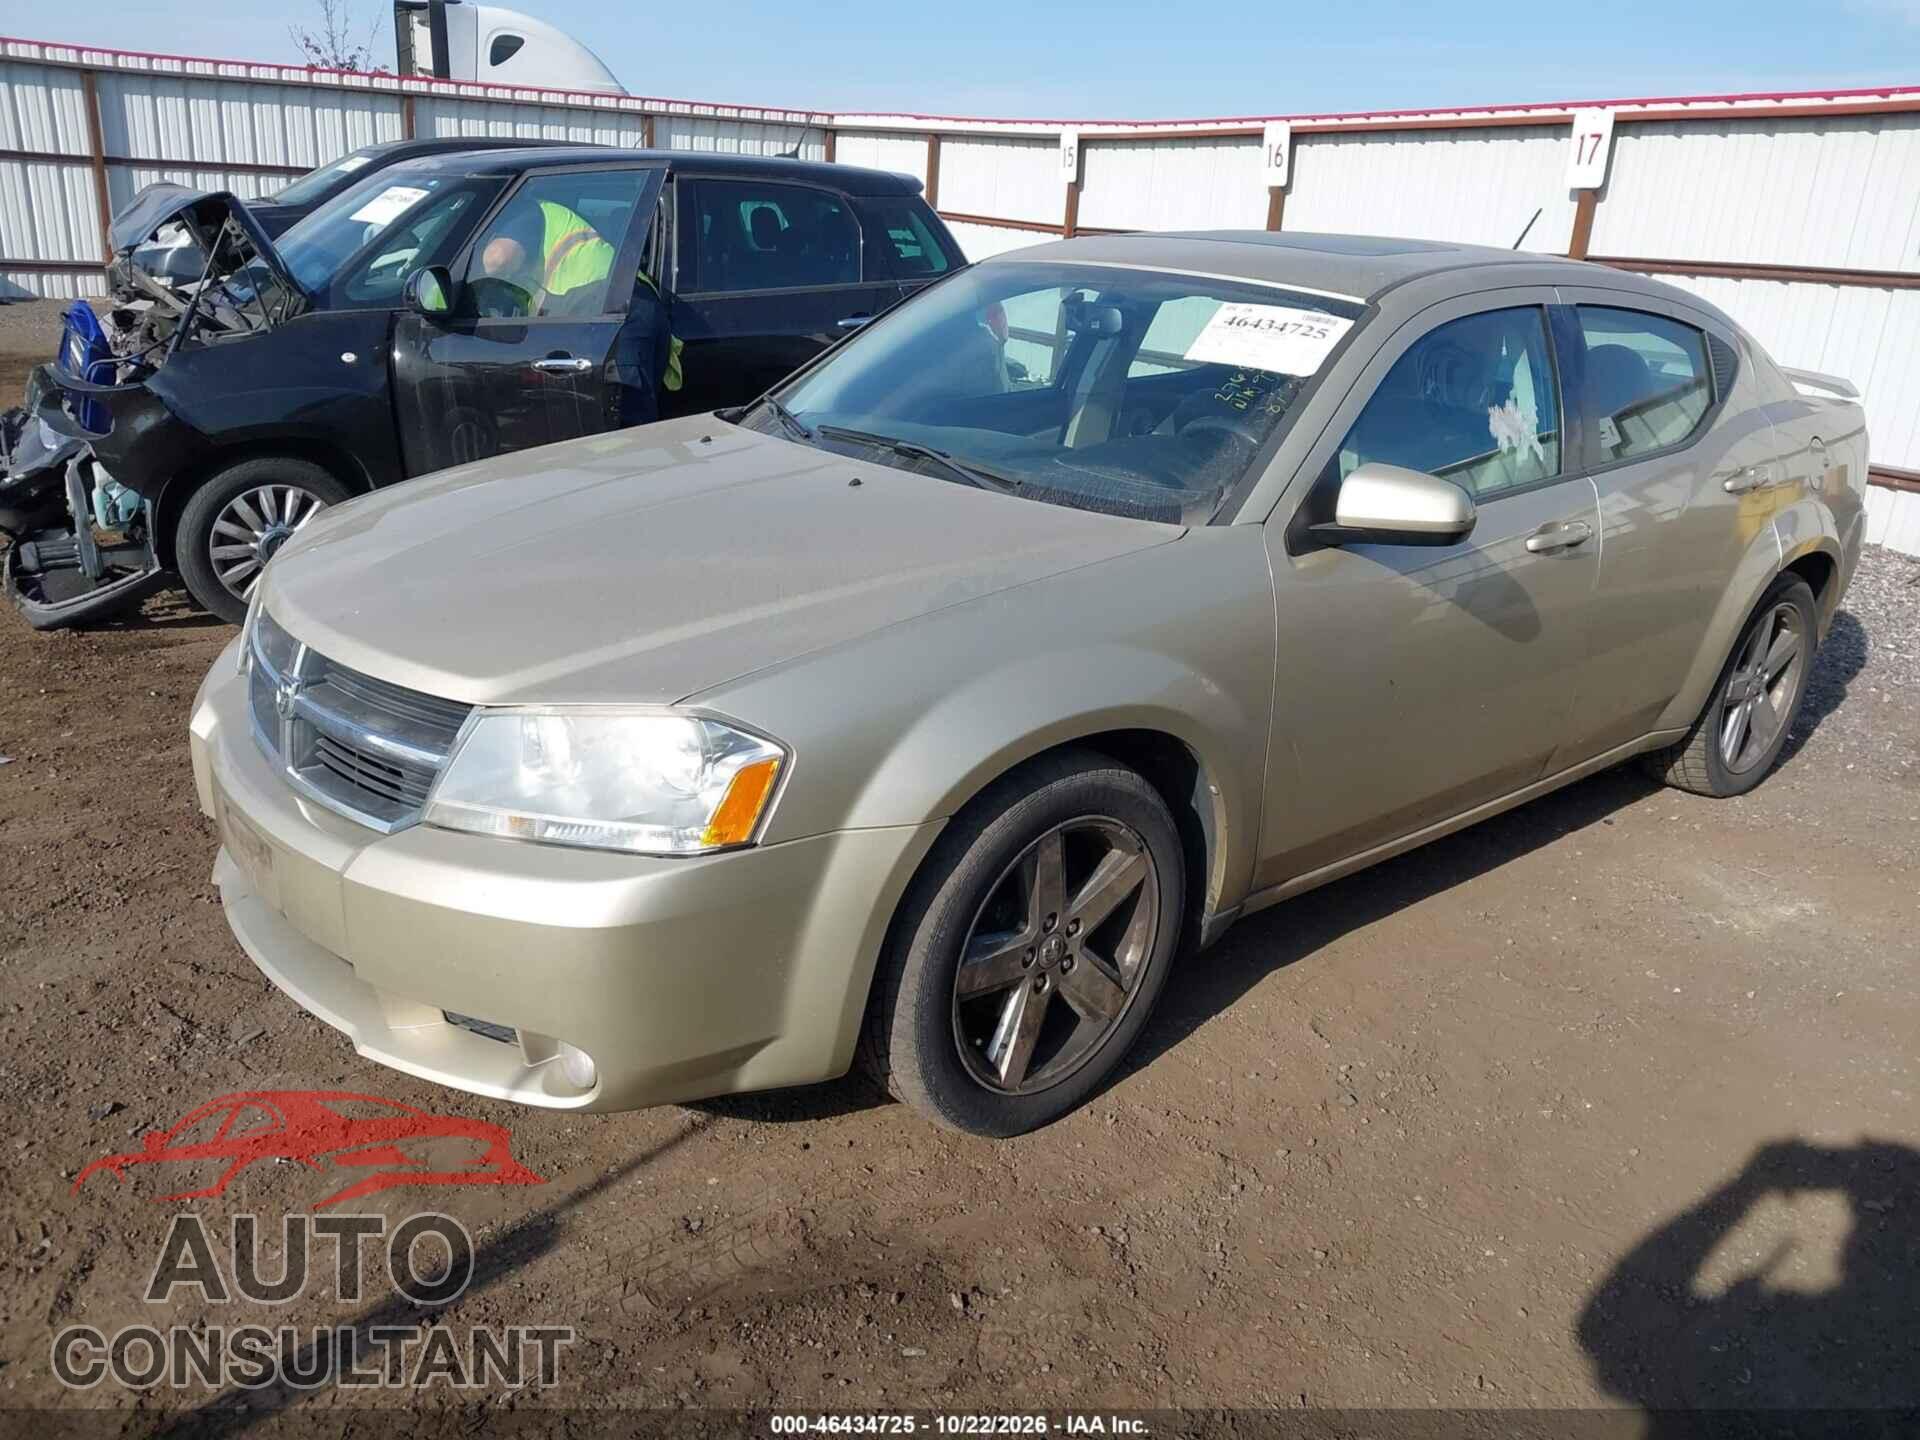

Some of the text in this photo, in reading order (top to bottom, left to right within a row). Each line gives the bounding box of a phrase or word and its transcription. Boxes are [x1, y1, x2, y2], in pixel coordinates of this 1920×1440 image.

[1063, 146, 1074, 168] 15
[1268, 143, 1284, 168] 16
[1576, 133, 1603, 166] 17
[1223, 316, 1329, 340] 46434725
